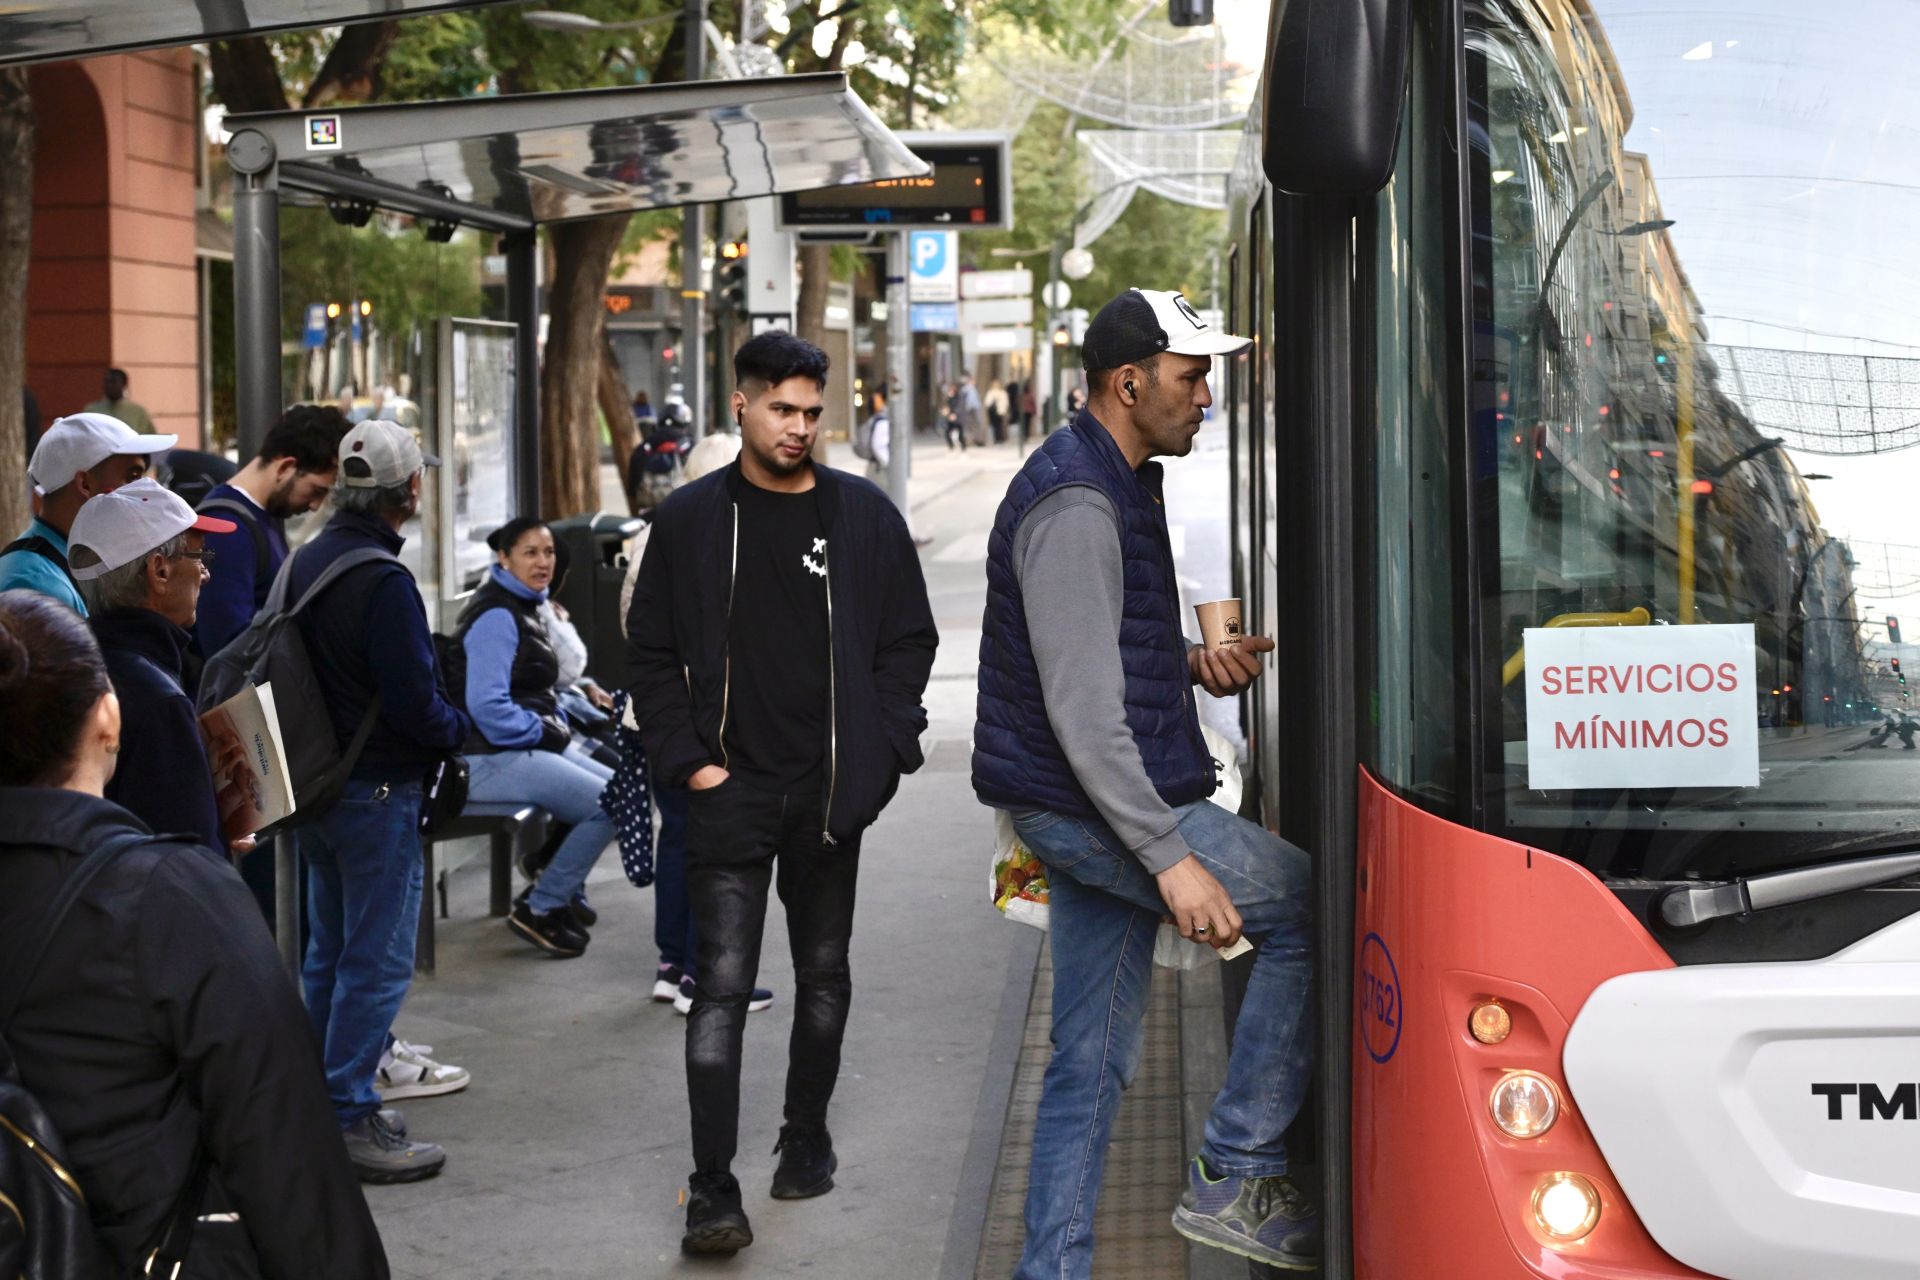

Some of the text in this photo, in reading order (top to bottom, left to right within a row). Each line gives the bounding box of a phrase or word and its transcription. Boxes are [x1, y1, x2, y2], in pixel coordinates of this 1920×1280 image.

[915, 237, 939, 269] P
[1541, 662, 1738, 696] SERVICIOS
[1554, 714, 1729, 750] MÍNIMOS
[1811, 1083, 1920, 1120] TM
